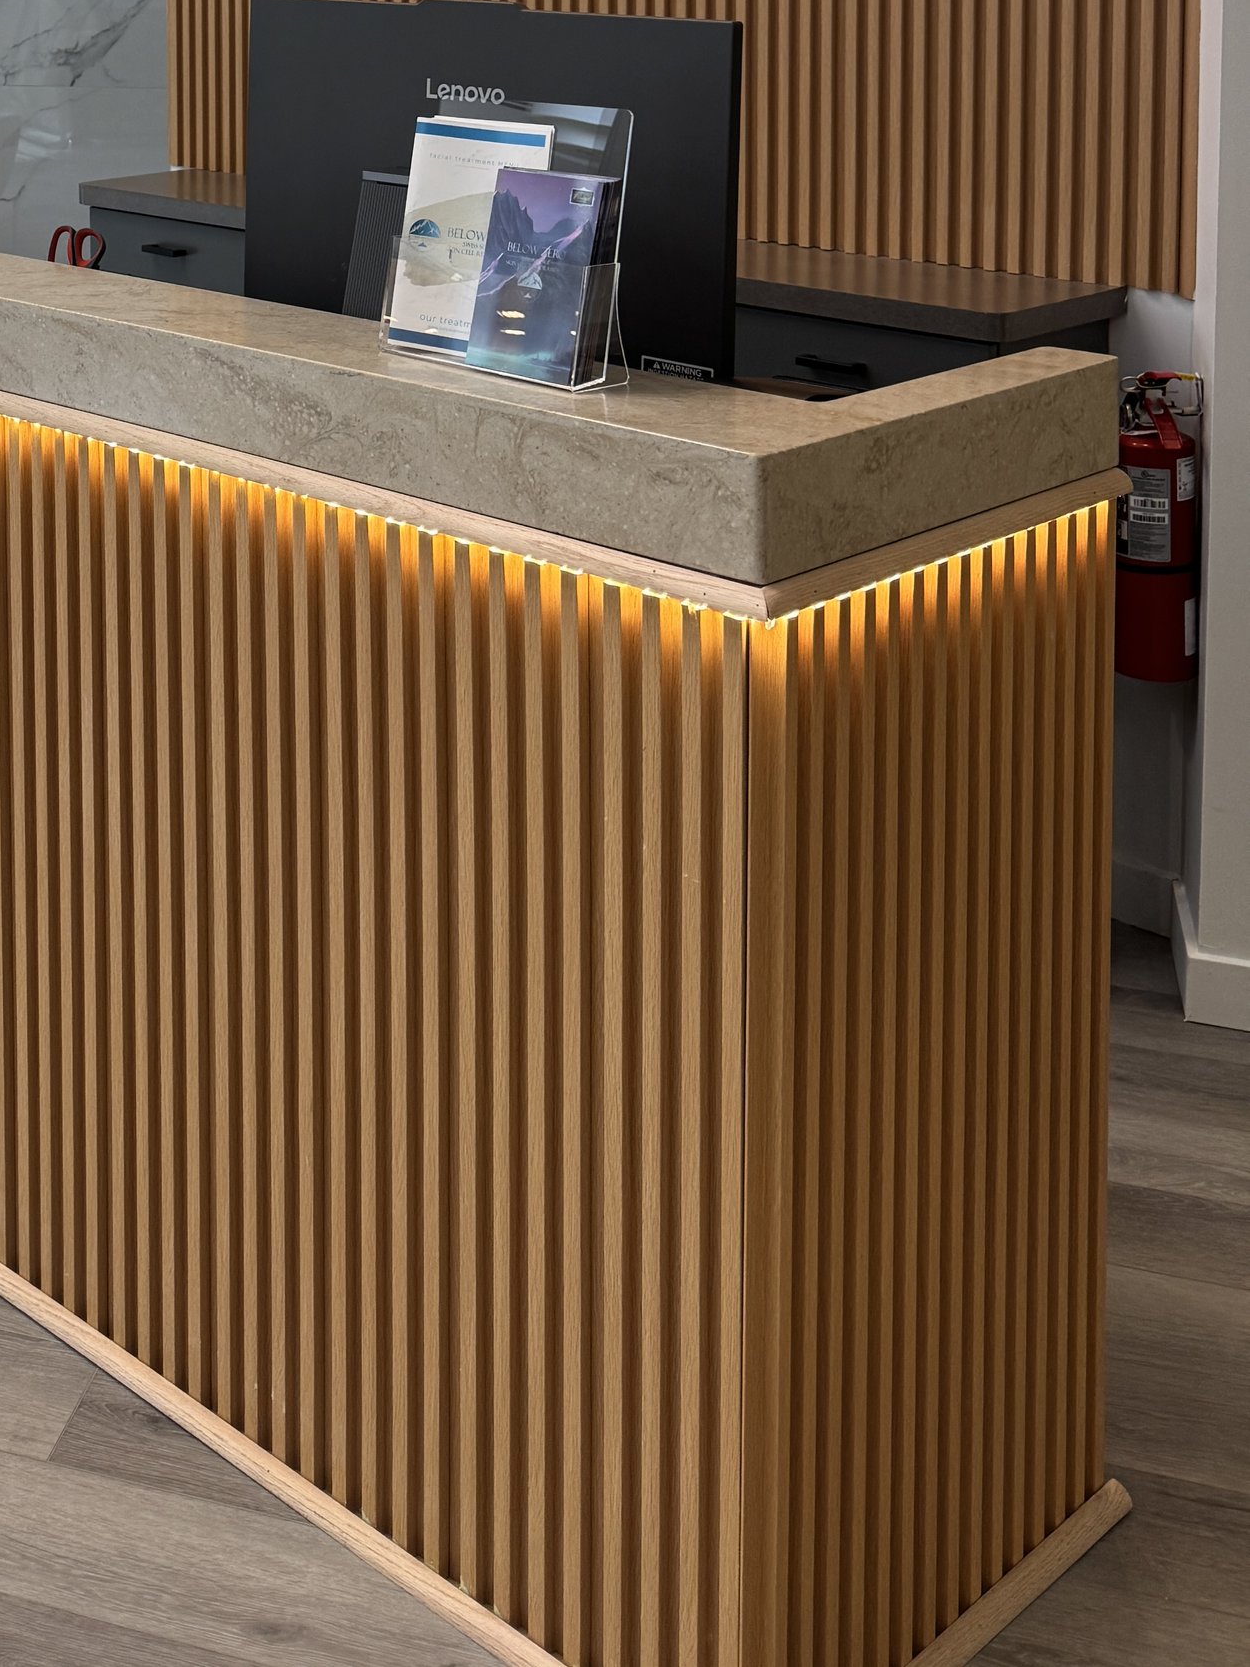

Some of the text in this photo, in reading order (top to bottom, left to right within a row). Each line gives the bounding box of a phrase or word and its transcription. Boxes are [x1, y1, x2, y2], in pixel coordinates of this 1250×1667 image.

[426, 78, 505, 105] Lenovo
[430, 152, 452, 160] facial
[454, 155, 495, 166] treatment
[447, 227, 486, 242] BELOW
[507, 241, 537, 255] BELOW
[420, 314, 436, 323] our
[661, 362, 702, 377] WARNING
